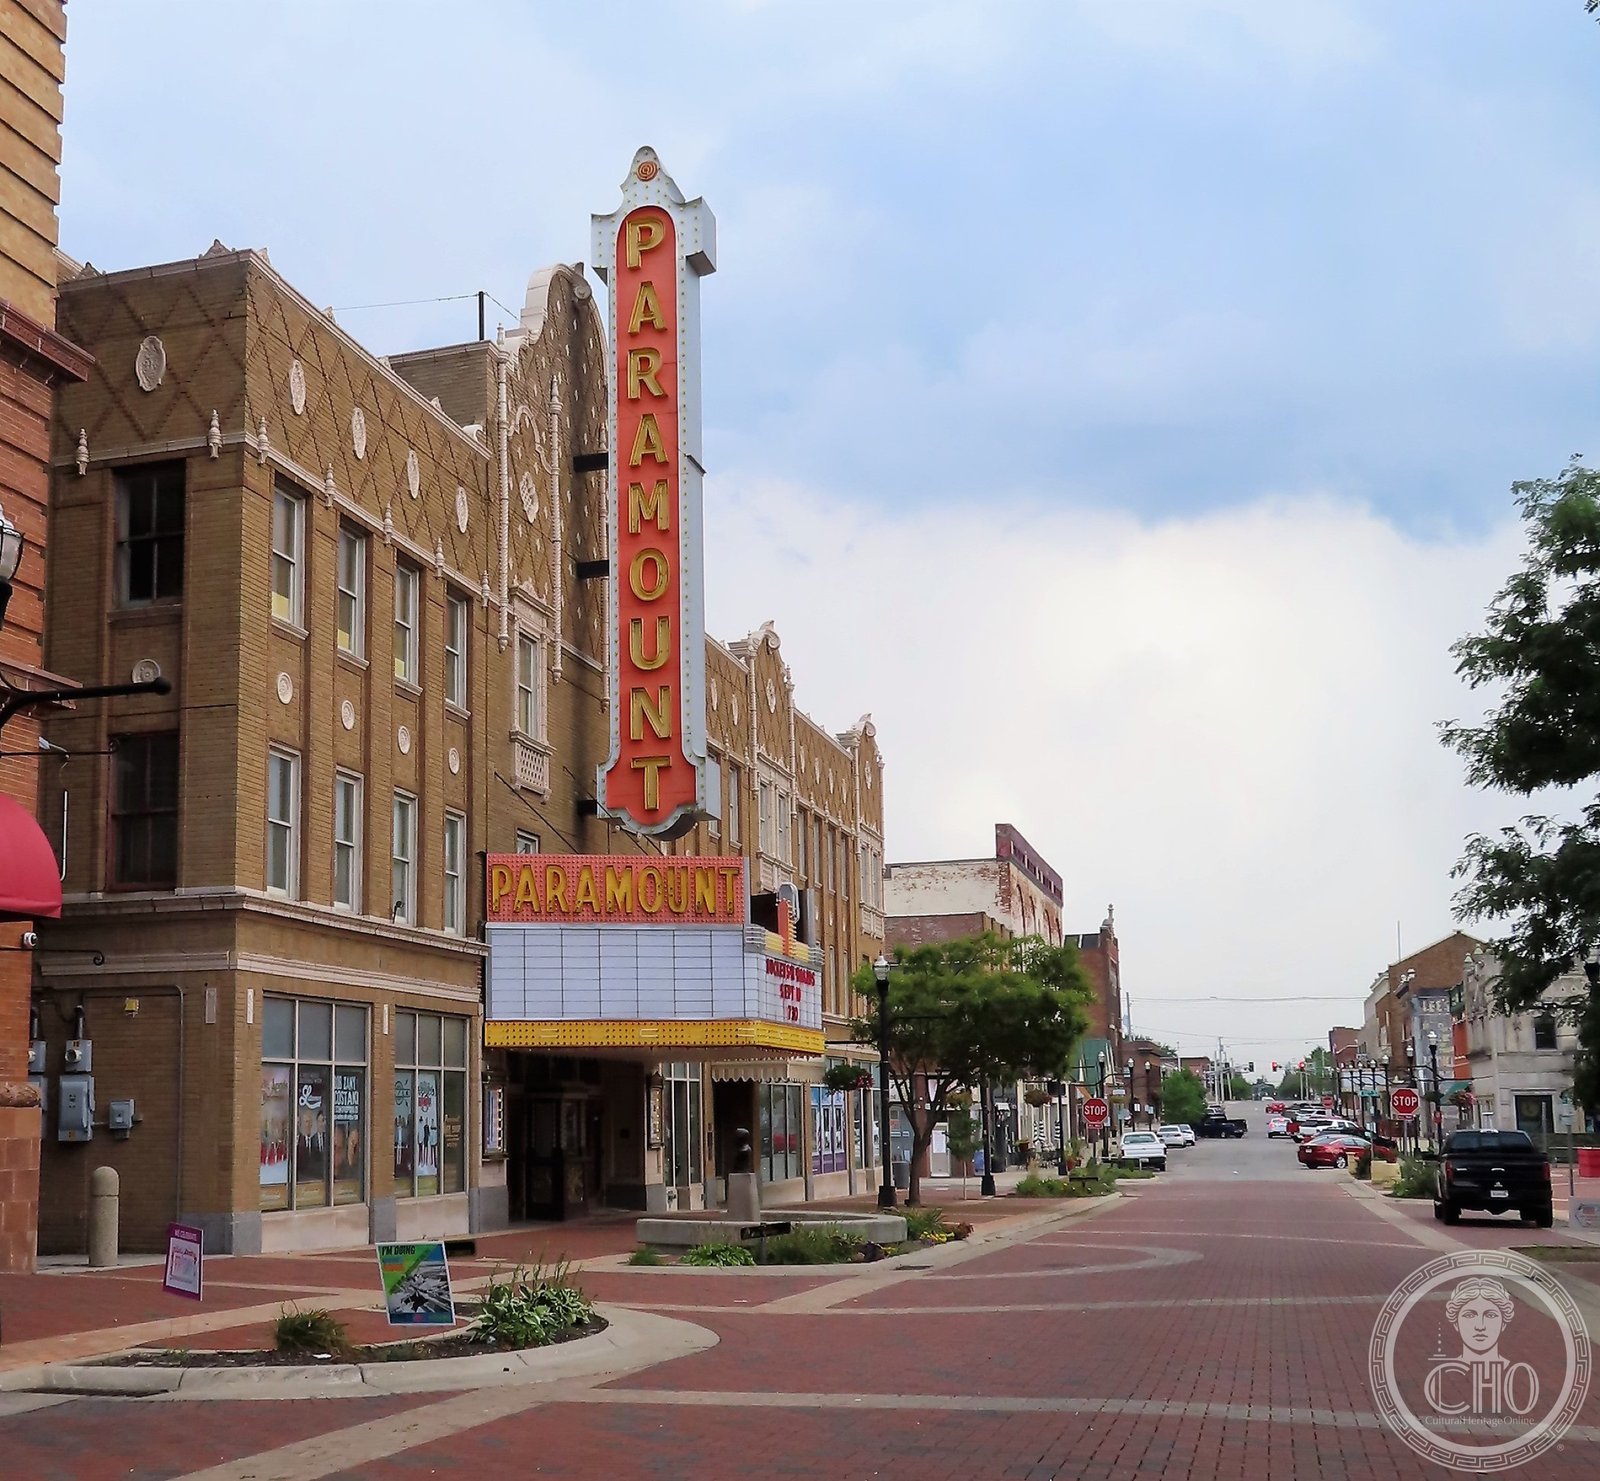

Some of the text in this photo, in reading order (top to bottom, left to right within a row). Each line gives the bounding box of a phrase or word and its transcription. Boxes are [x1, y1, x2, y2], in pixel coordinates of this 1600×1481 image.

[625, 216, 672, 811] PARAMOUNT
[490, 863, 740, 914] PARAMOUNT
[1084, 1105, 1106, 1116] STOP
[1393, 1096, 1418, 1107] STOP
